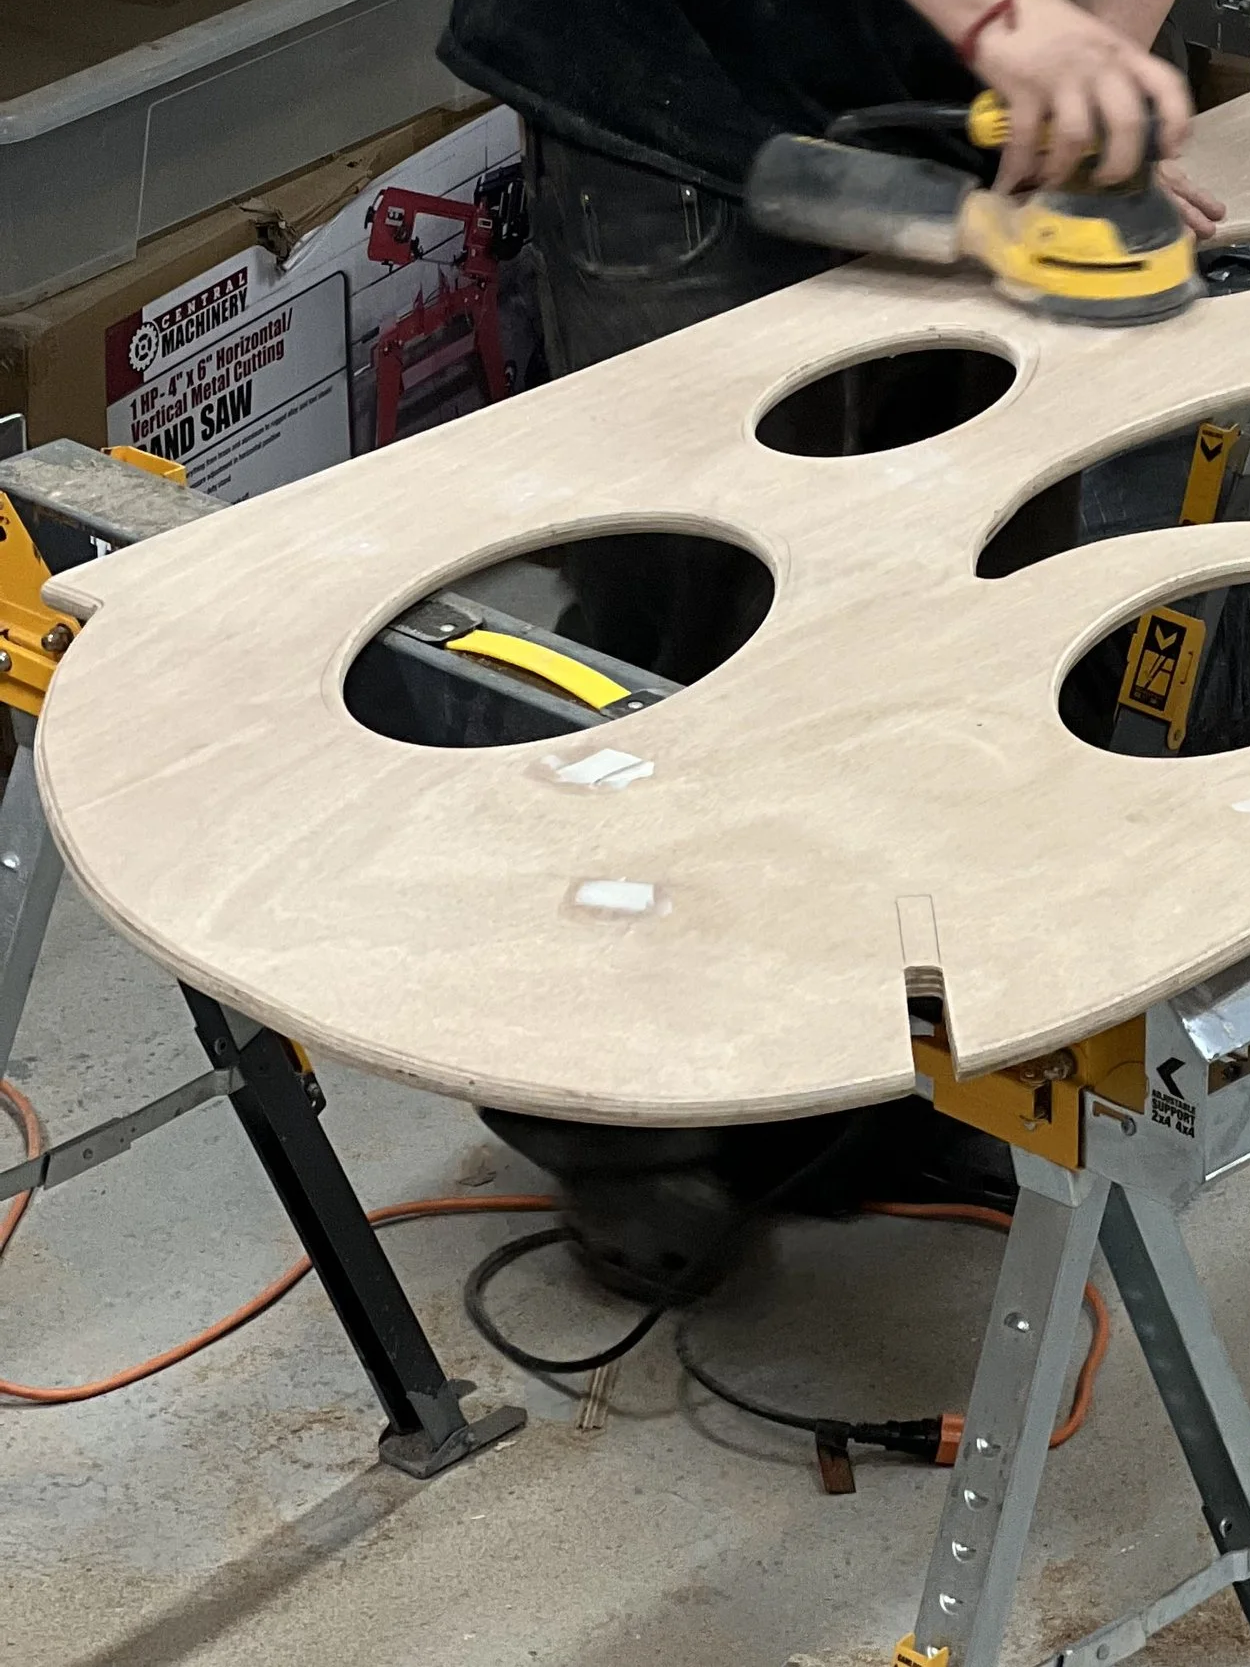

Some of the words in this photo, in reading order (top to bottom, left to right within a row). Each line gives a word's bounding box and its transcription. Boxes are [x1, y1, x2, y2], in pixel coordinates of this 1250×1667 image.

[161, 272, 246, 329] CENTRAL
[161, 287, 248, 358] MACHINERY
[130, 399, 137, 420] 1
[168, 371, 183, 397] 4"
[186, 368, 194, 389] x
[198, 353, 213, 382] 6"
[216, 307, 293, 371] Horizontal/
[131, 392, 187, 443] Vertical
[191, 369, 230, 409] Metal
[233, 339, 285, 382] Cutting
[137, 415, 195, 461] AND
[200, 379, 253, 442] SAW
[1151, 1109, 1172, 1128] 2x4
[1175, 1121, 1196, 1139] 4x4
[1152, 1088, 1196, 1114] ADJUSTABLE
[1152, 1097, 1196, 1126] SUPPORT
